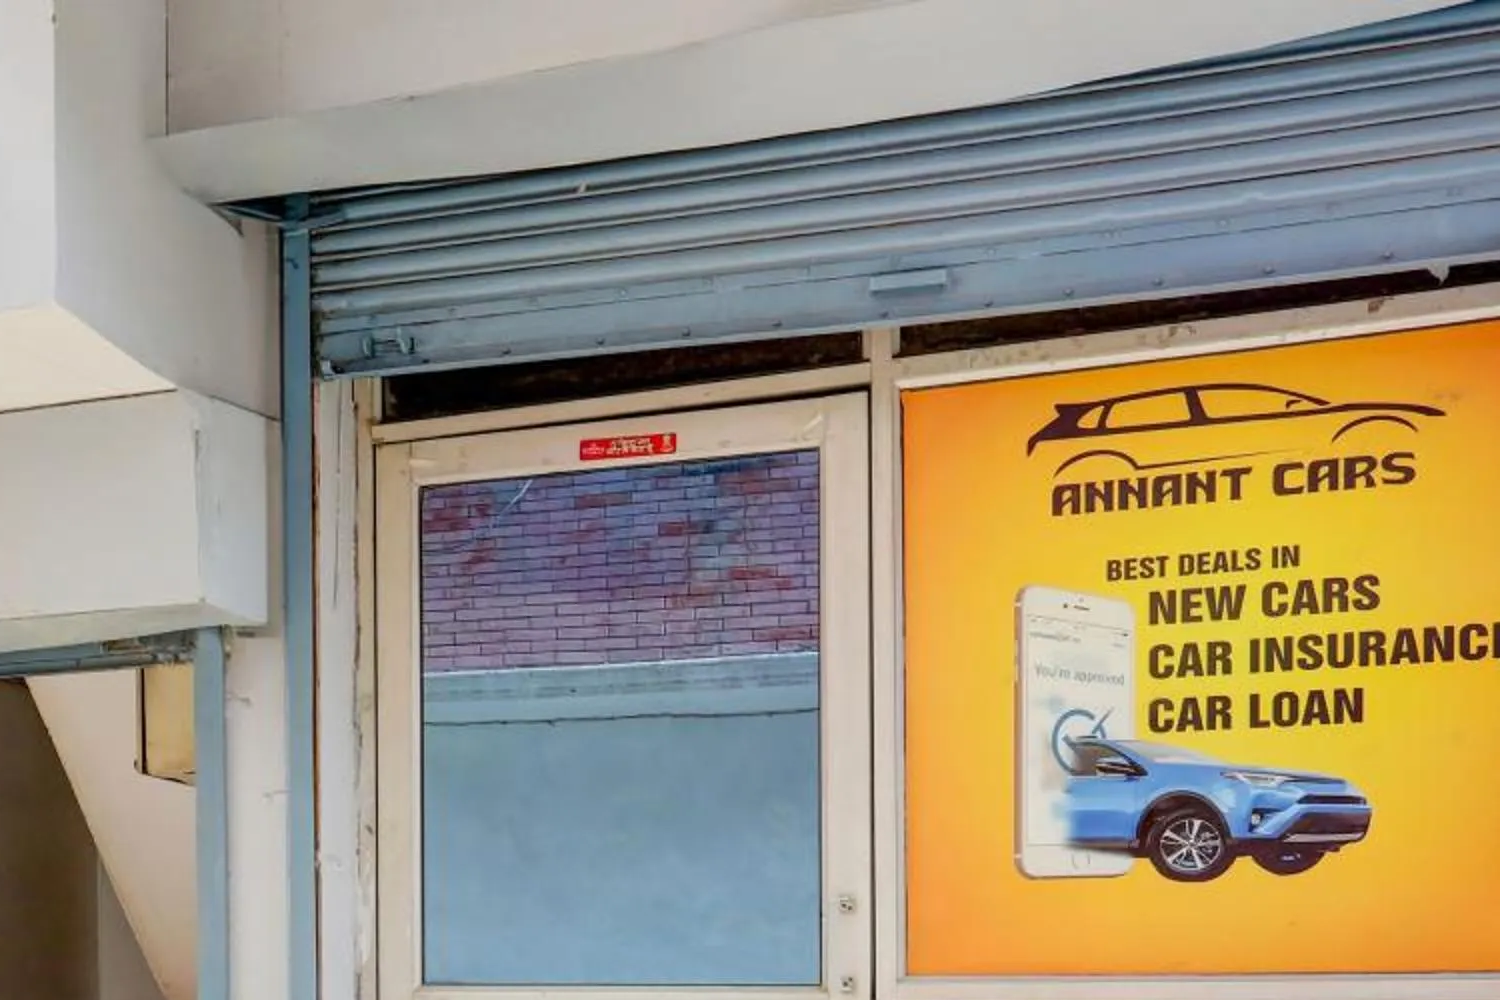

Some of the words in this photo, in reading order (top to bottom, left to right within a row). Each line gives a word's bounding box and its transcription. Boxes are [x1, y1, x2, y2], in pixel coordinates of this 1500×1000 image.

[1051, 466, 1253, 517] ANNANT
[1271, 451, 1416, 497] CARS
[1106, 555, 1170, 582] BEST
[1177, 547, 1261, 577] DEALS
[1270, 544, 1301, 569] IN
[1148, 583, 1247, 626] NEW
[1260, 573, 1381, 617] CARS
[1148, 640, 1233, 679] CAR
[1148, 695, 1233, 733] CAR
[1248, 687, 1364, 729] LOAN
